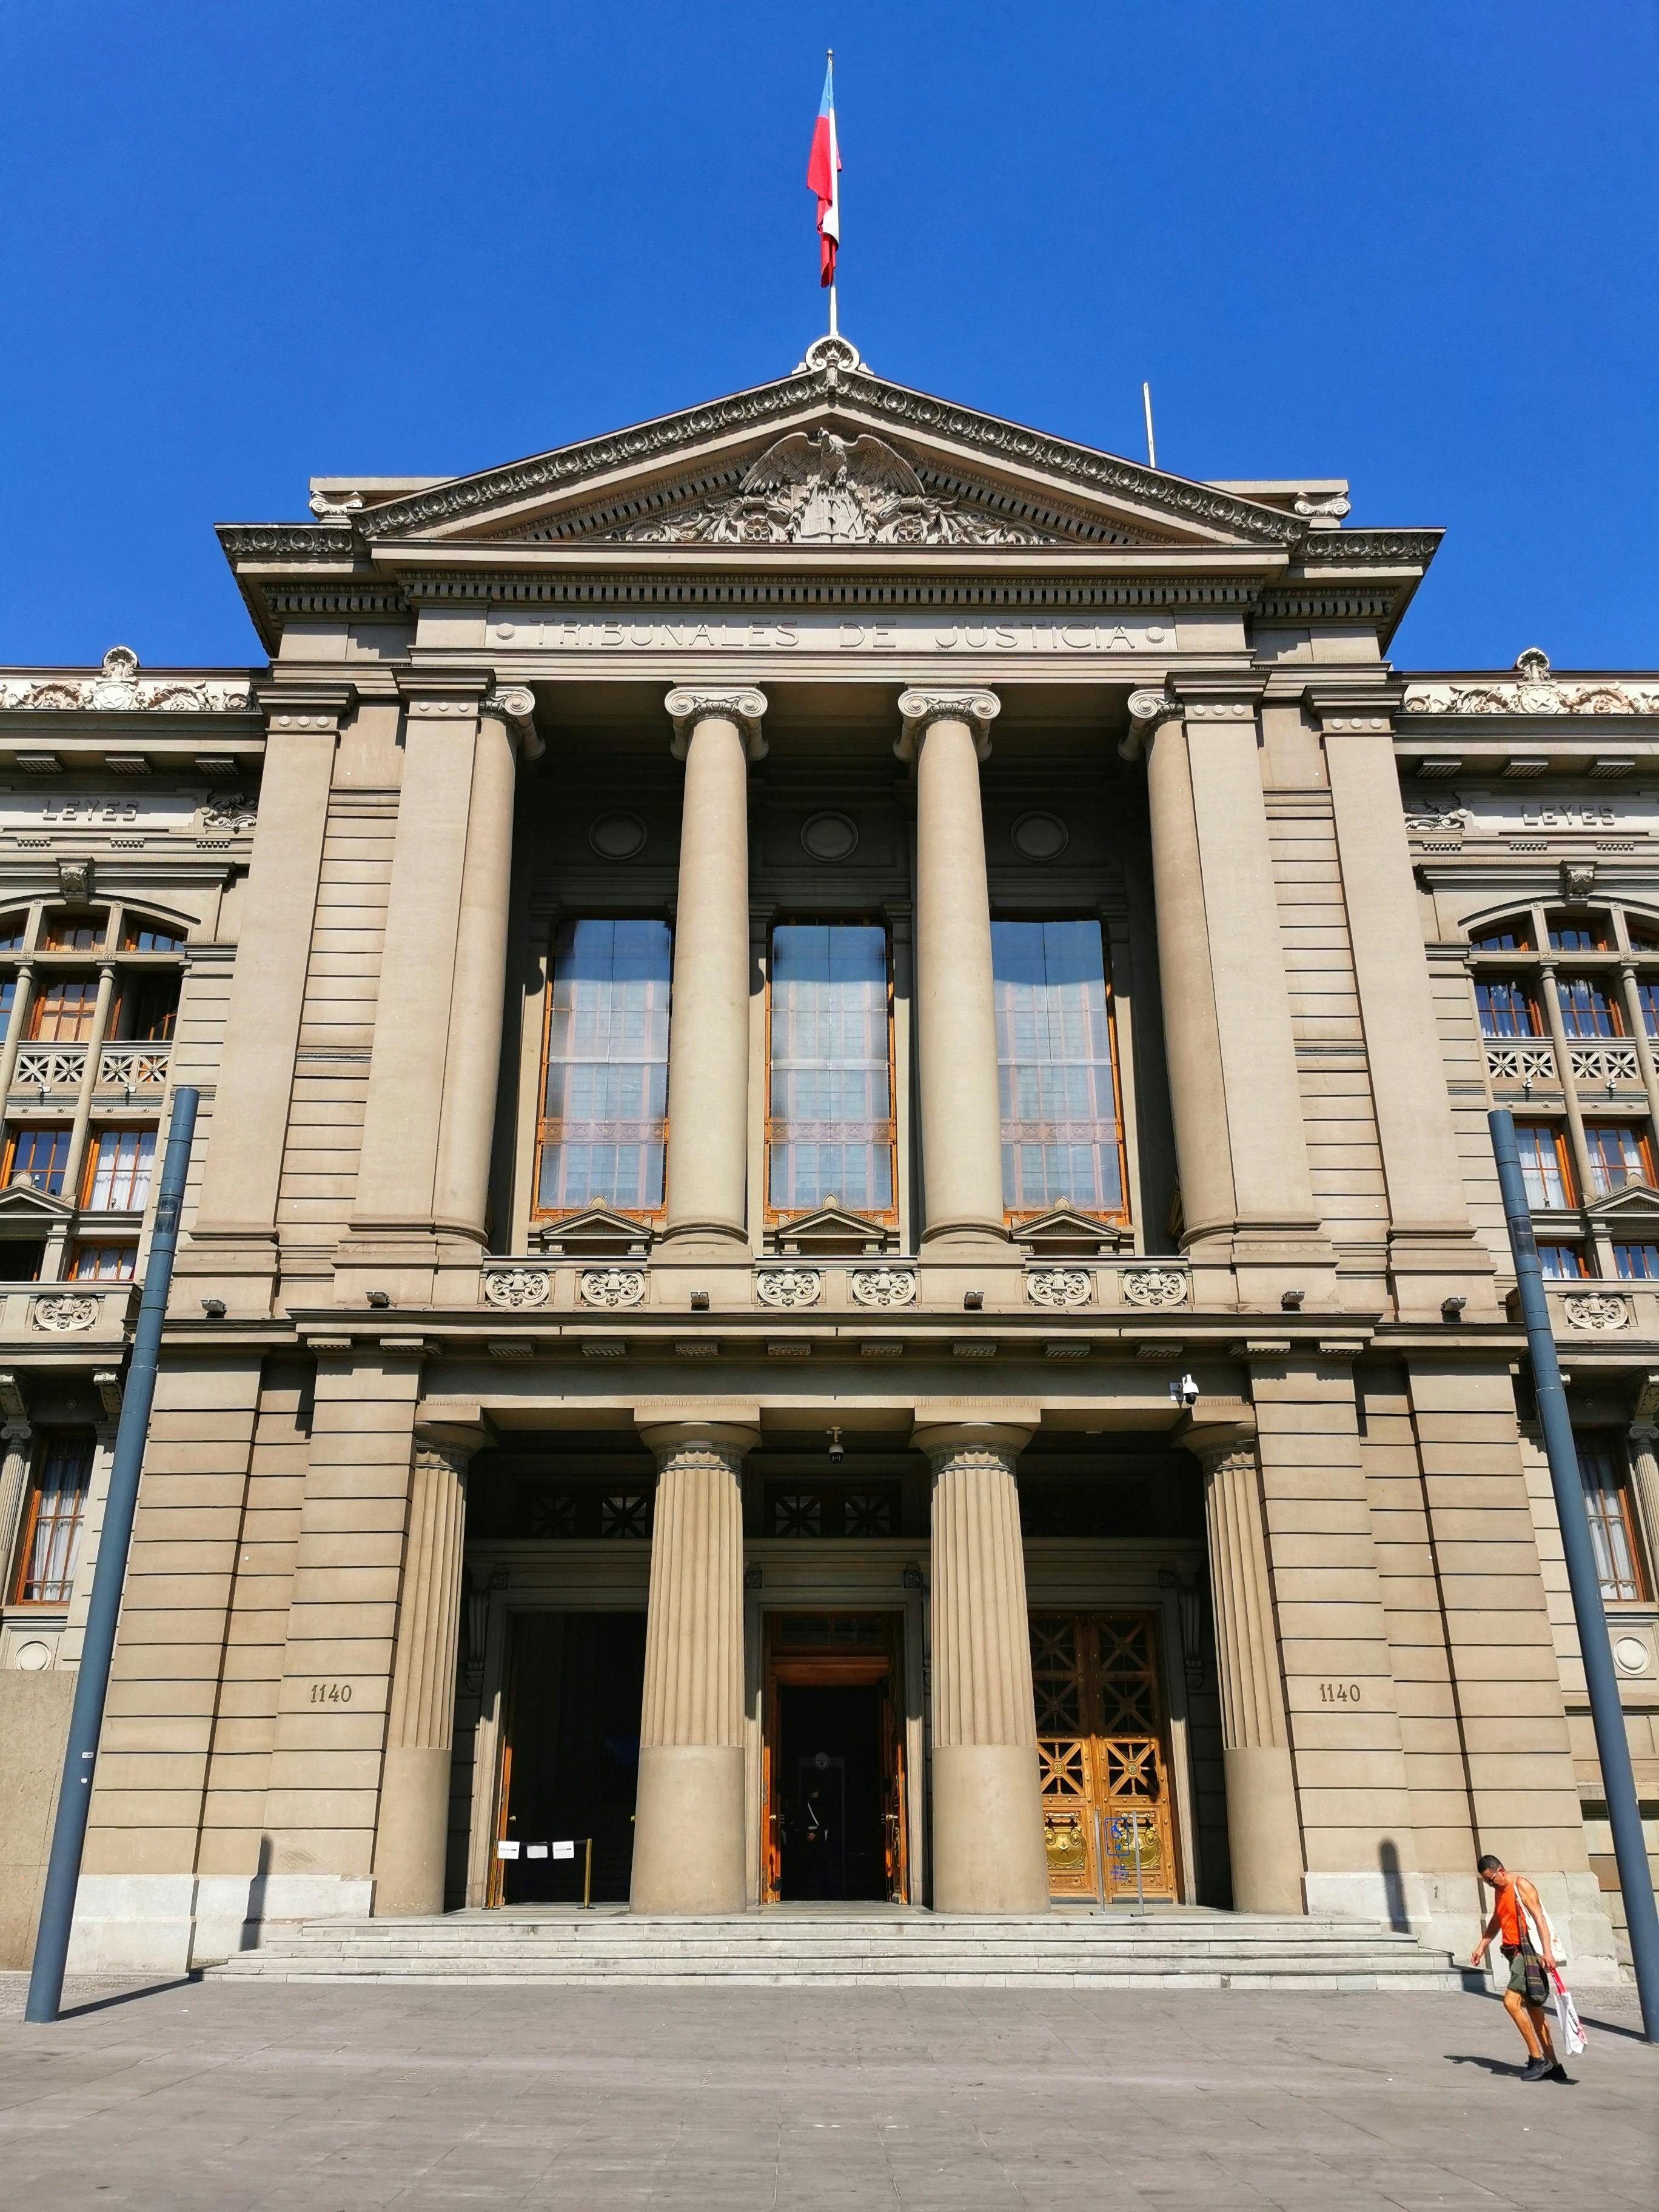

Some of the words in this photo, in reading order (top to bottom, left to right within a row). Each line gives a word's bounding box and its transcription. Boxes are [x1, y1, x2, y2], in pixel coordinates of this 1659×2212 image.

[529, 618, 800, 647] TRIBUNALES
[839, 621, 897, 648] DE
[934, 620, 1136, 649] JUSTICIA
[42, 800, 139, 822] LEYES
[1520, 805, 1616, 826] LEYES
[310, 1683, 352, 1703] 1140
[1319, 1683, 1361, 1702] 1140
